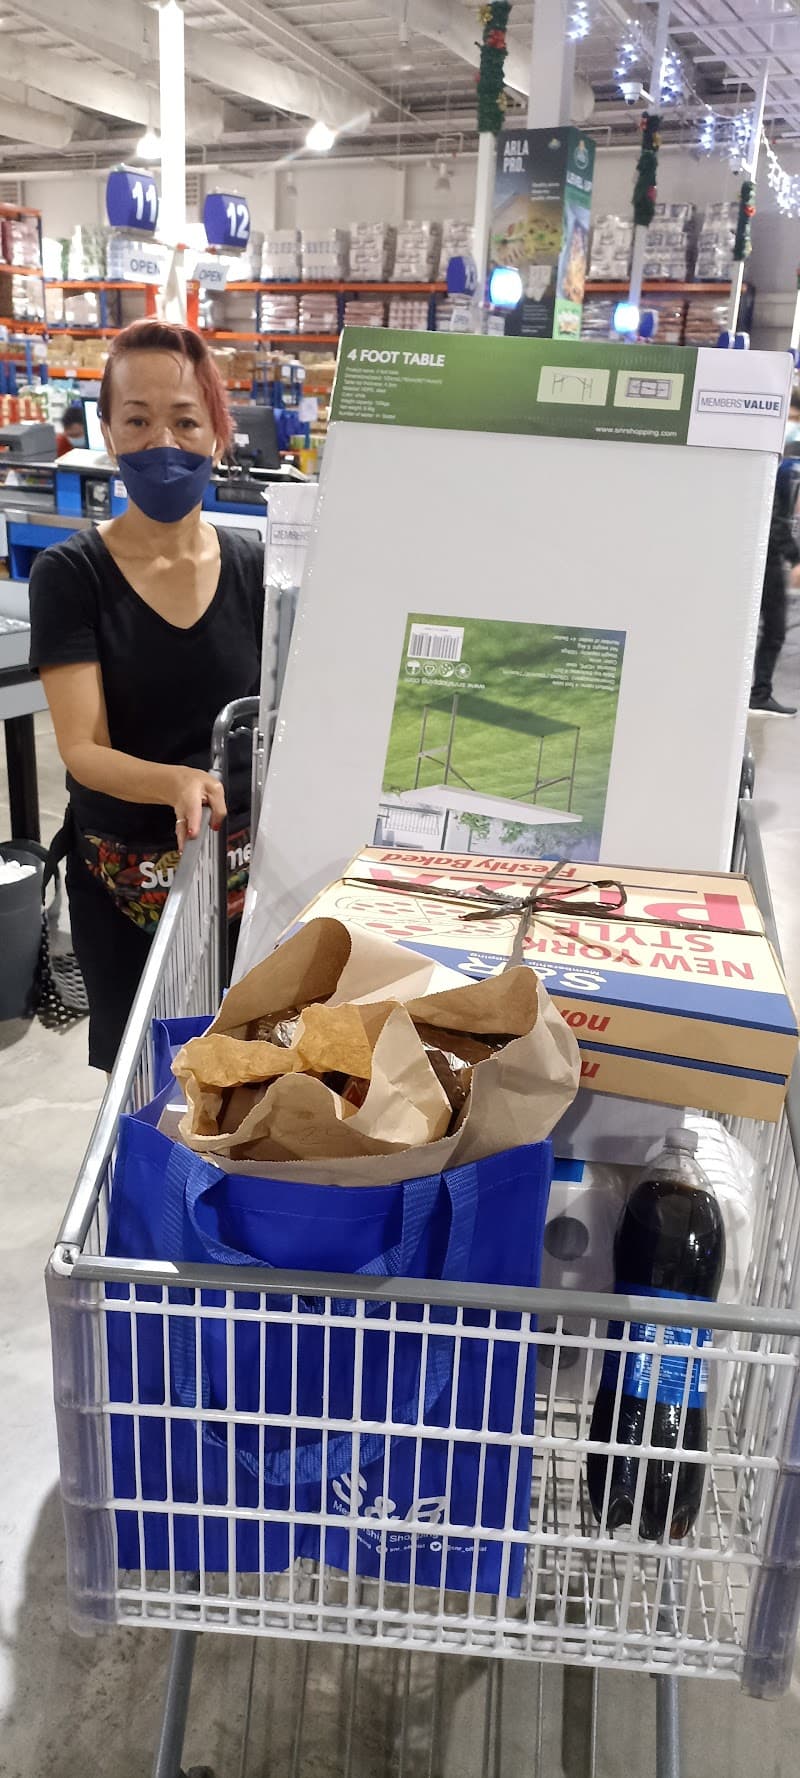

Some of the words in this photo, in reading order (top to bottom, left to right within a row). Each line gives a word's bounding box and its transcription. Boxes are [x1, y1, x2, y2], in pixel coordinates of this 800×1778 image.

[504, 140, 528, 156] ARLA
[132, 181, 157, 223] 11
[226, 202, 249, 239] 12
[199, 270, 224, 281] OPEN
[347, 348, 357, 361] 4
[360, 349, 400, 363] FOOT
[402, 351, 446, 367] TABLE
[380, 853, 472, 869] Baked
[472, 857, 576, 878] Feshly
[553, 919, 714, 953] STYLE
[522, 936, 641, 966] YORK
[650, 952, 755, 980] NEW
